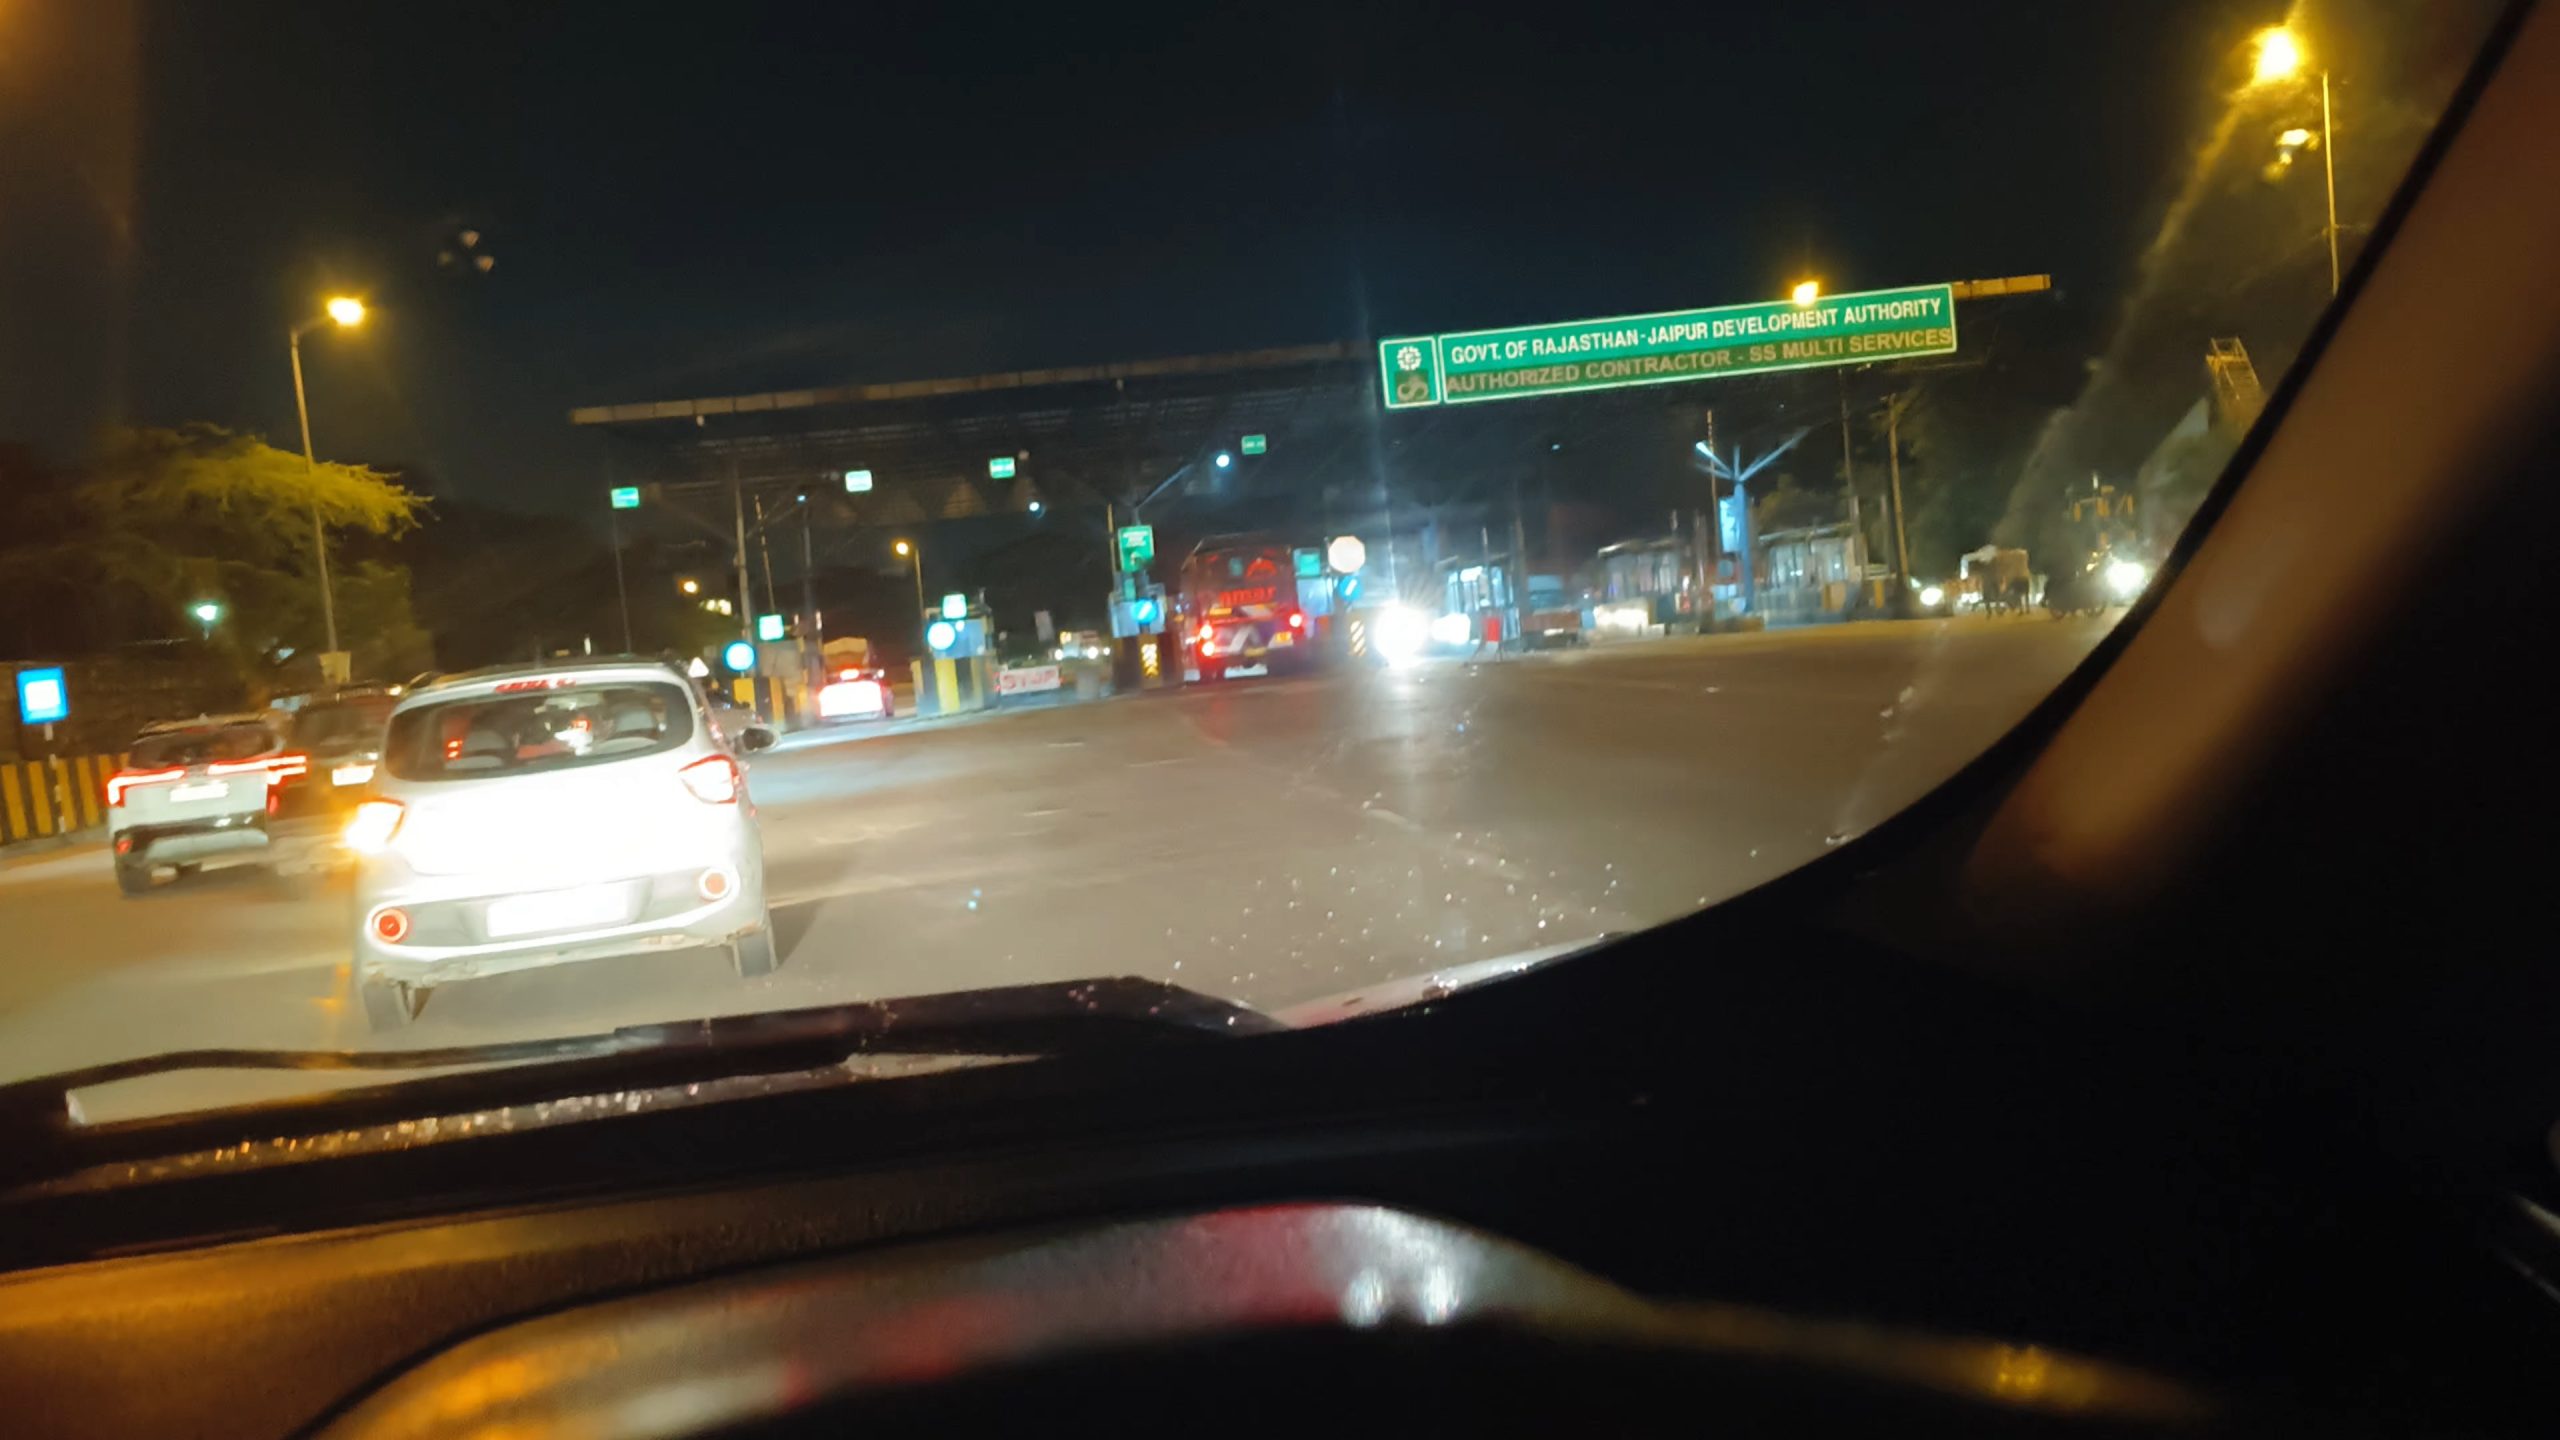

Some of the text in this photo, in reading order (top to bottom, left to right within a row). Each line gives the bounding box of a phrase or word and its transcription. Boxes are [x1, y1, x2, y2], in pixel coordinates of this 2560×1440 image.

[1447, 364, 1580, 392] AUTHORIZED
[1585, 350, 1732, 379] CONTRACTOR
[1750, 345, 1777, 362] SS
[1782, 338, 1844, 359] MULTI
[1849, 328, 1952, 352] SERVICES
[1451, 343, 1501, 364] GOVT.
[1505, 340, 1528, 359] OF
[1712, 309, 1838, 337] DEVELOPMENT
[1844, 298, 1941, 319] AUTHORITY
